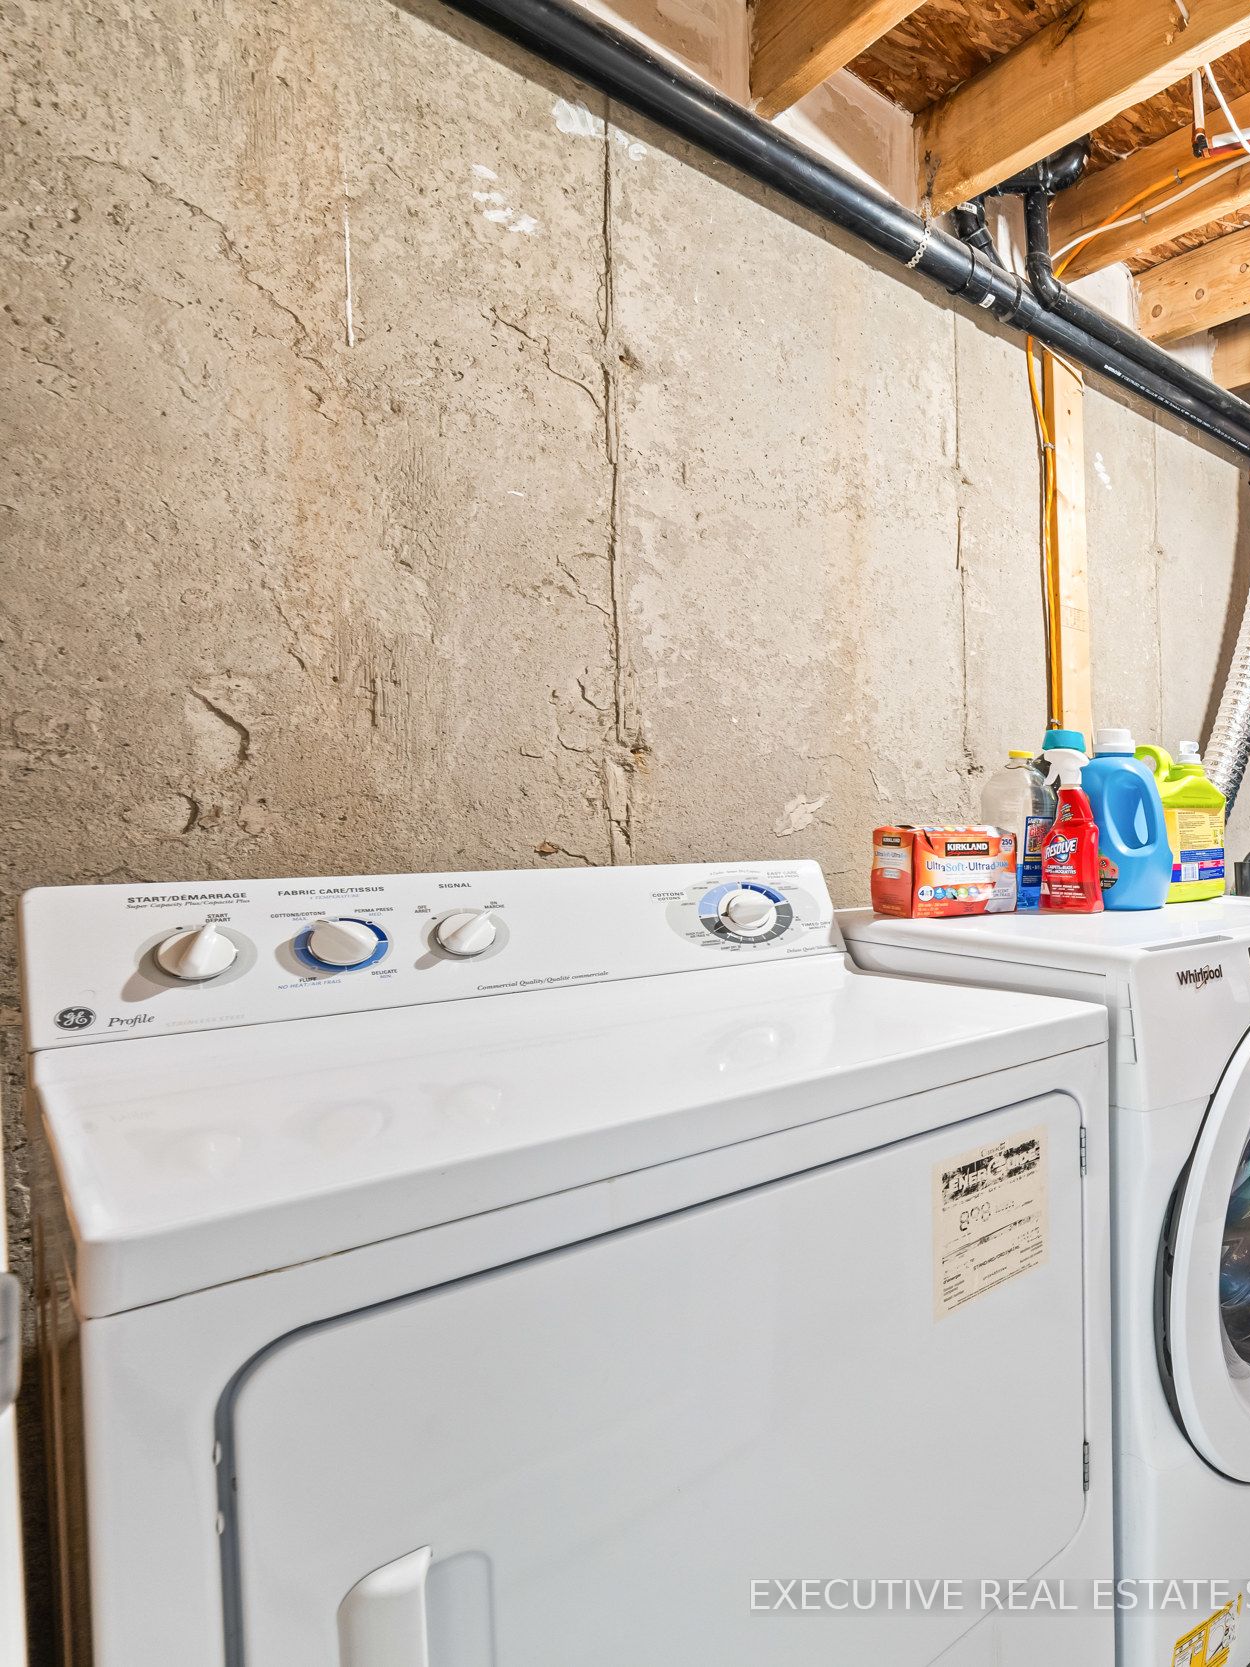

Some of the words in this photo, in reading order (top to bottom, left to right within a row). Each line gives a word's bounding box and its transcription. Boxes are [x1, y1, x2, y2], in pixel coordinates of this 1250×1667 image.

[947, 843, 988, 851] KIRKLAND
[1046, 839, 1077, 859] RESOLVE
[127, 892, 247, 904] START/DÉMARRAGE
[277, 889, 316, 897] FABRIC
[319, 886, 385, 895] CARE/TISSUS
[1176, 964, 1222, 985] Whirlpool
[108, 1013, 155, 1027] Profile
